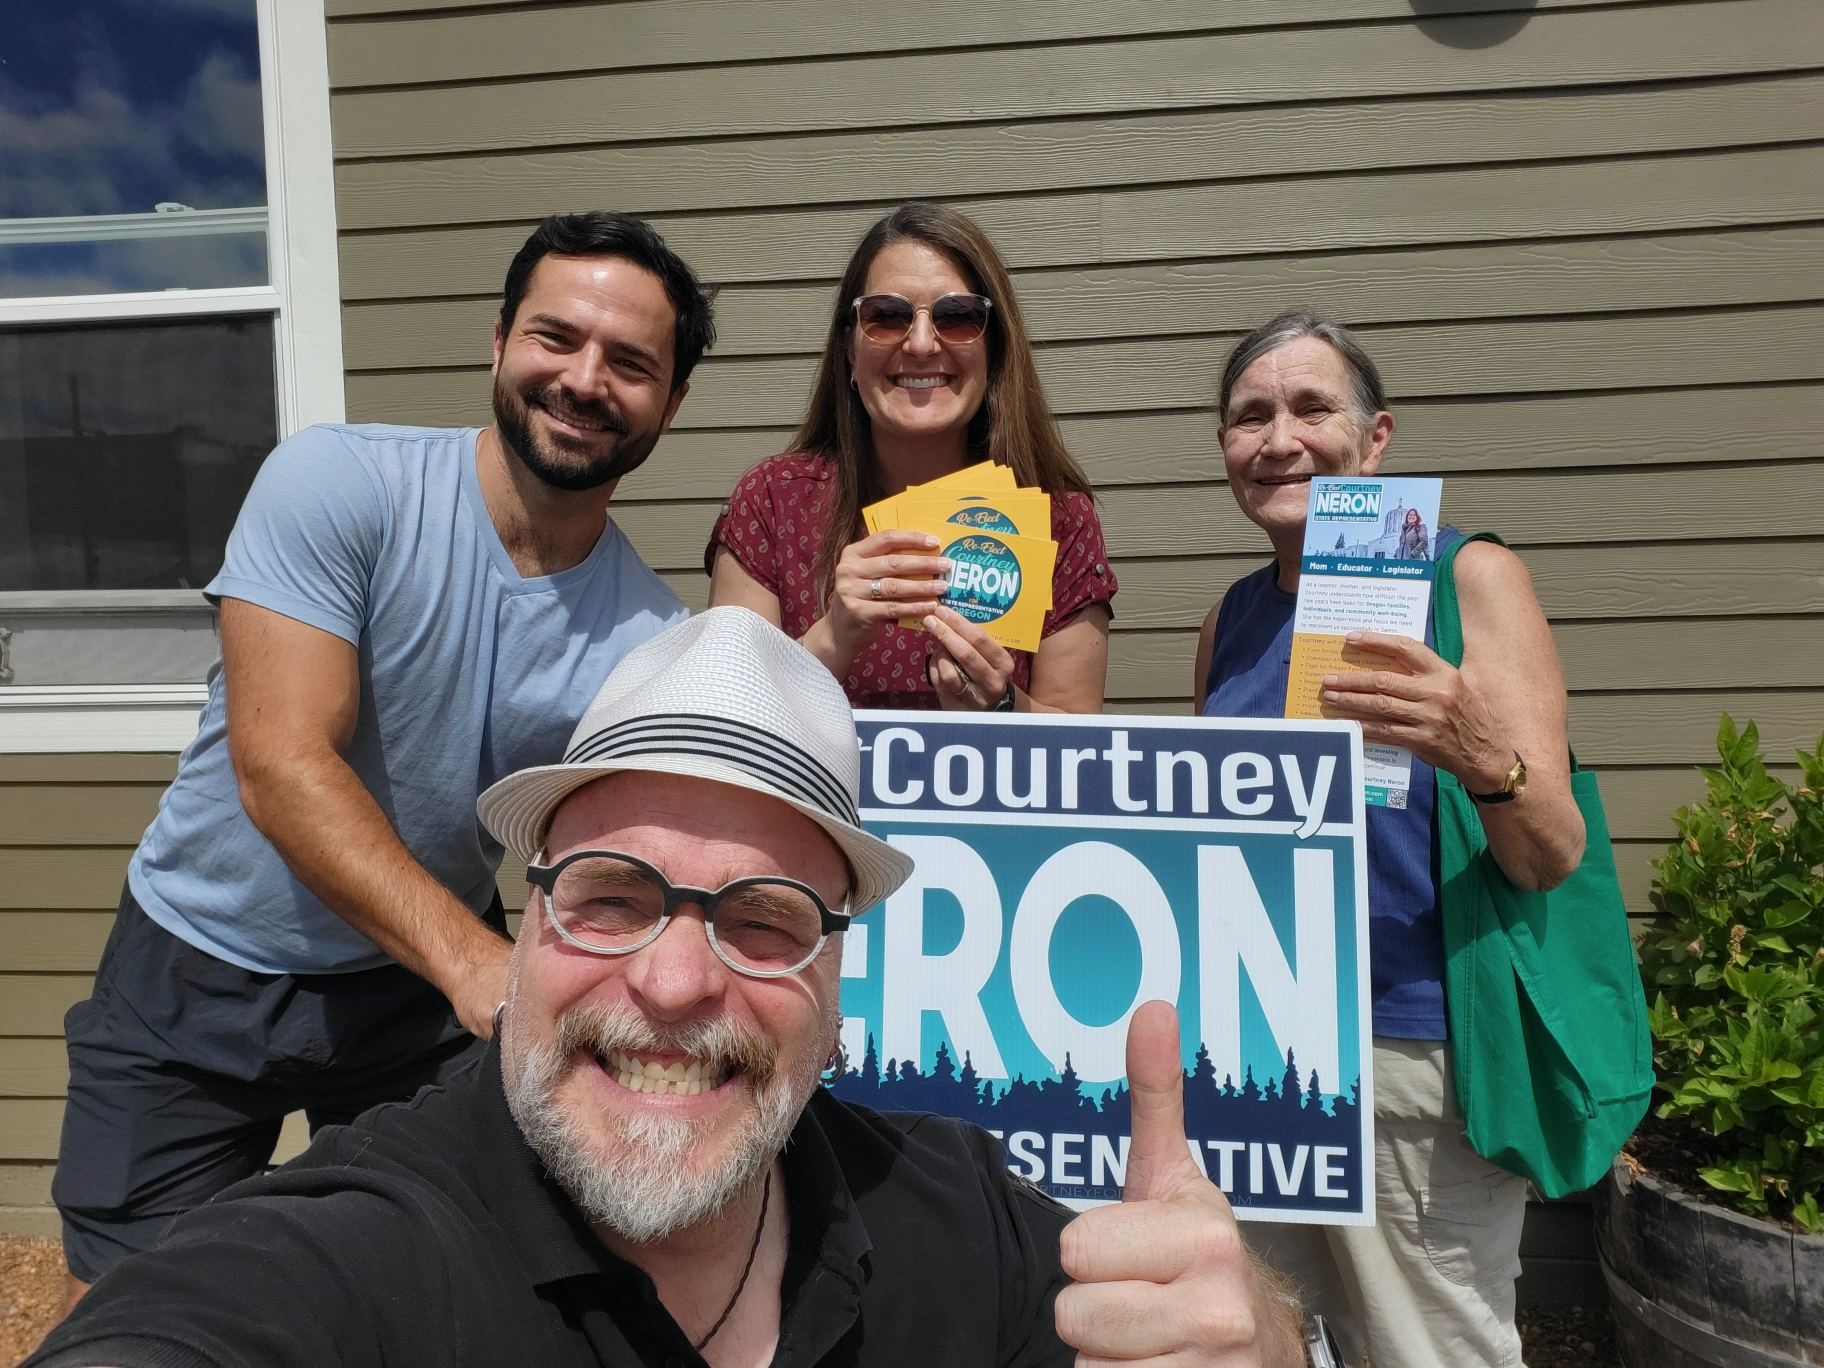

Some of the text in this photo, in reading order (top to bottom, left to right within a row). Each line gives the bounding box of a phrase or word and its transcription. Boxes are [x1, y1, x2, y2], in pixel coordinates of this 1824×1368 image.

[1316, 493, 1380, 514] NERON
[956, 511, 1001, 526] Re-Elect
[962, 538, 1008, 555] Re-Elect
[946, 545, 1015, 573] Courtney
[1309, 562, 1424, 575] Mom Educator Legislator
[958, 602, 1004, 615] REPRESENTATIVE
[1364, 755, 1391, 763] regonians
[1374, 748, 1399, 756] investing
[872, 727, 1336, 839] Courtney
[1364, 776, 1405, 786] ourtney Neron
[840, 834, 1340, 1096] RON
